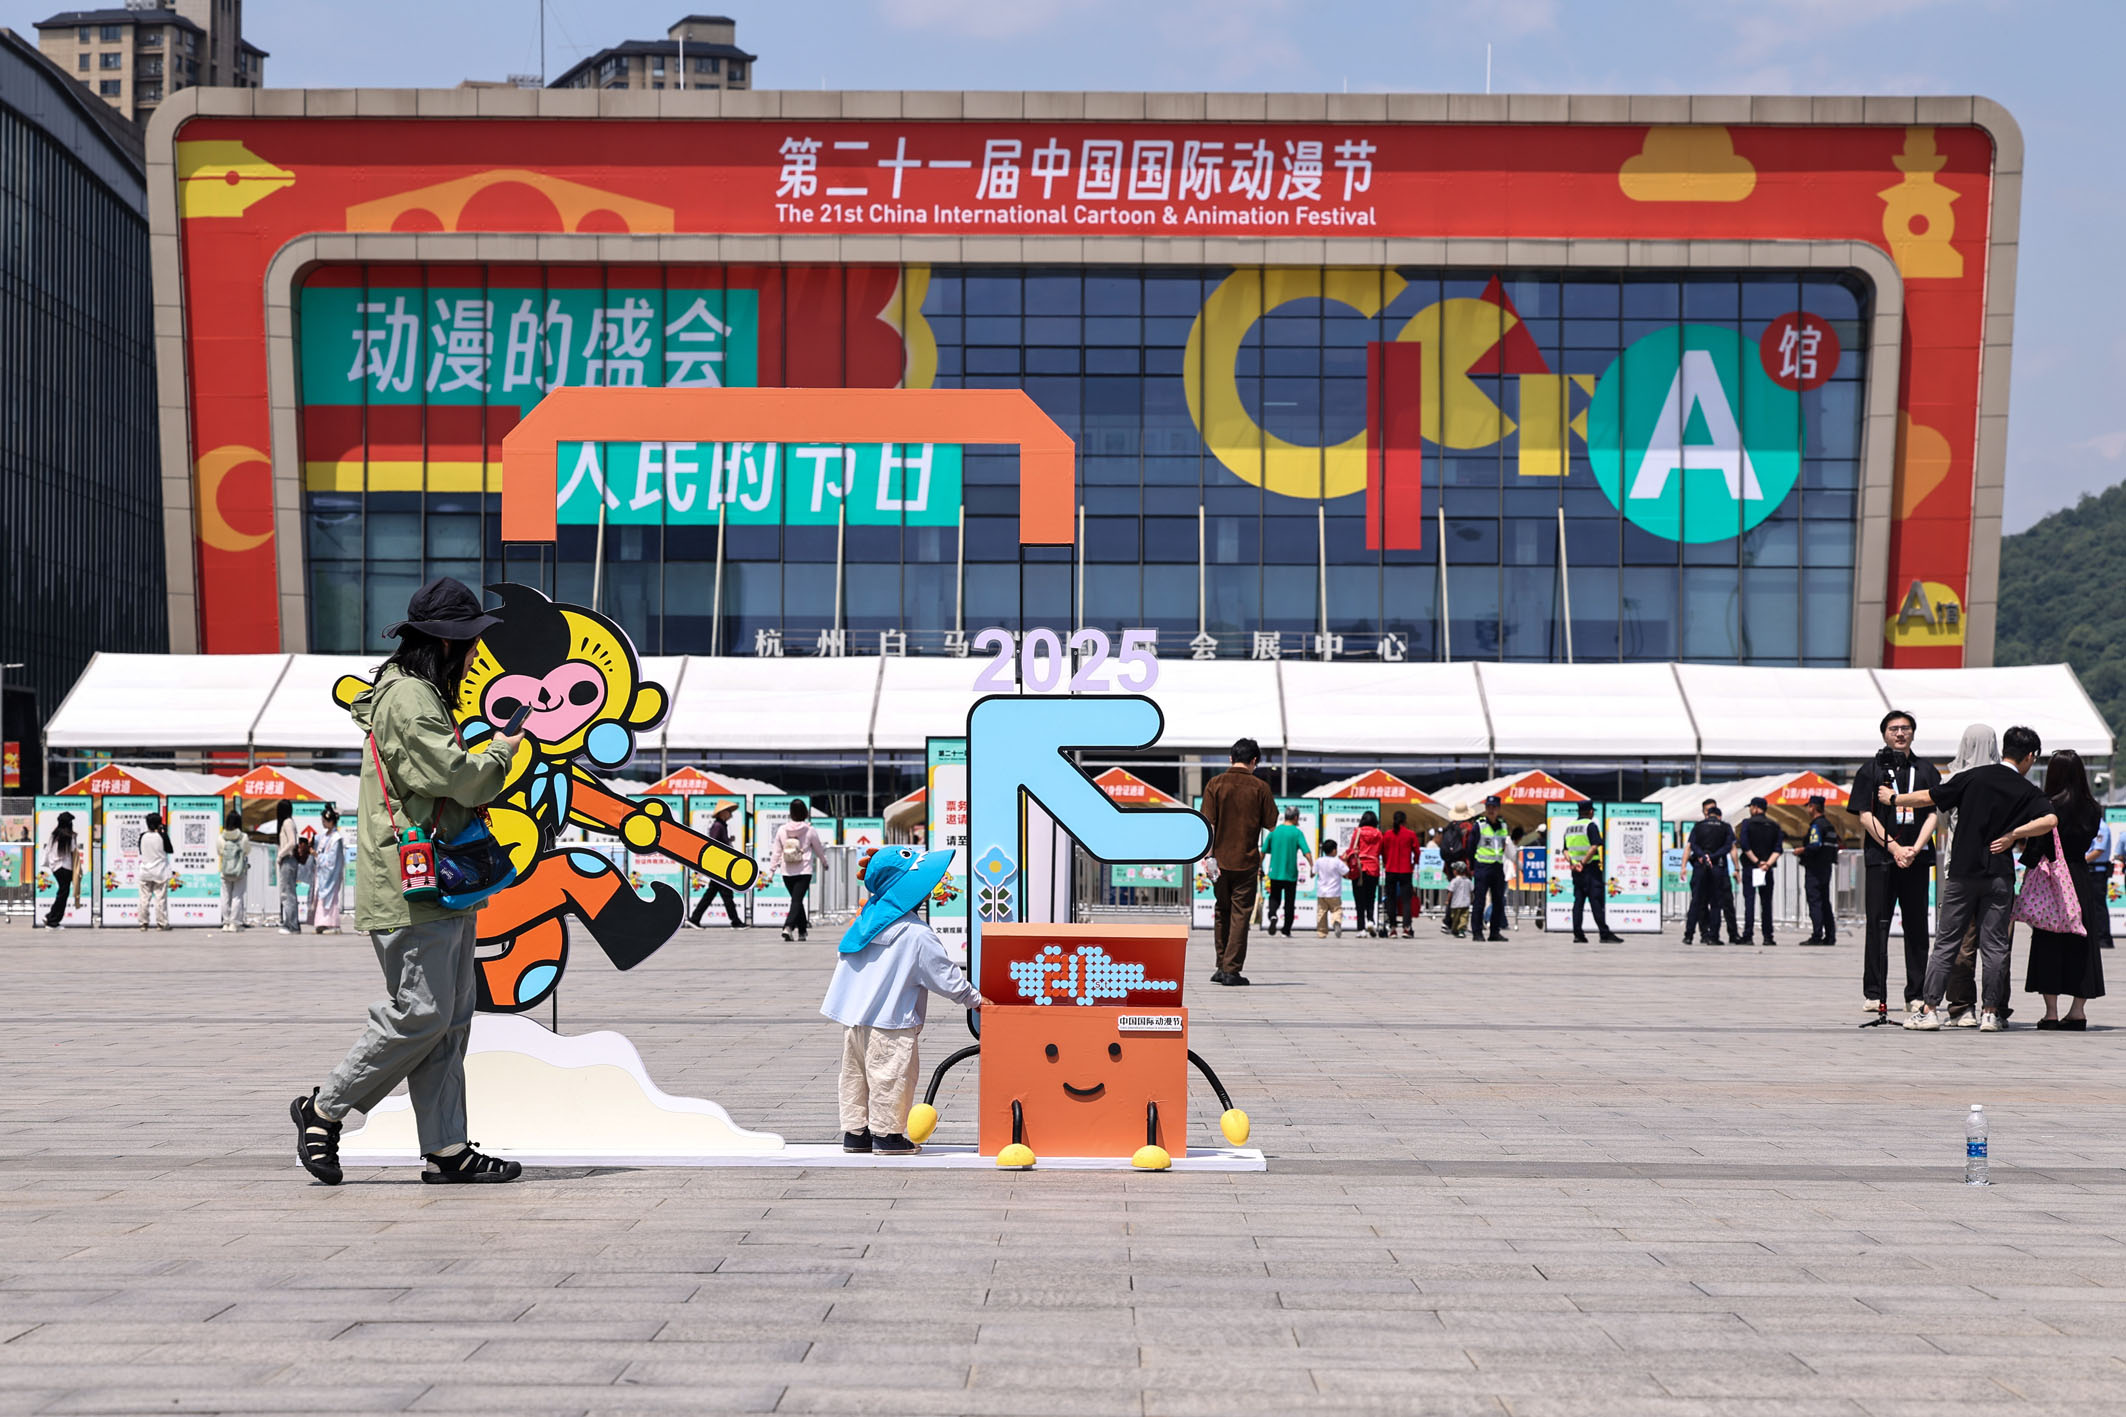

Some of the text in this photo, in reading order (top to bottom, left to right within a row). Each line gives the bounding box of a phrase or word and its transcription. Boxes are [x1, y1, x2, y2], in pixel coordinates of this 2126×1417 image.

[776, 136, 1377, 203] 第二十一届中国国际动漫节
[776, 204, 1376, 226] The 21st China International Cartoon & Animation Festival
[347, 296, 732, 393] 动漫的盛会
[1778, 324, 1822, 380] 馆
[1629, 350, 1764, 500] A
[557, 441, 934, 512] 人民的节日
[754, 627, 1407, 664] 杭州白马会展中心
[971, 626, 1160, 692] 2025
[1120, 1017, 1181, 1026] 中国国际动漫节
